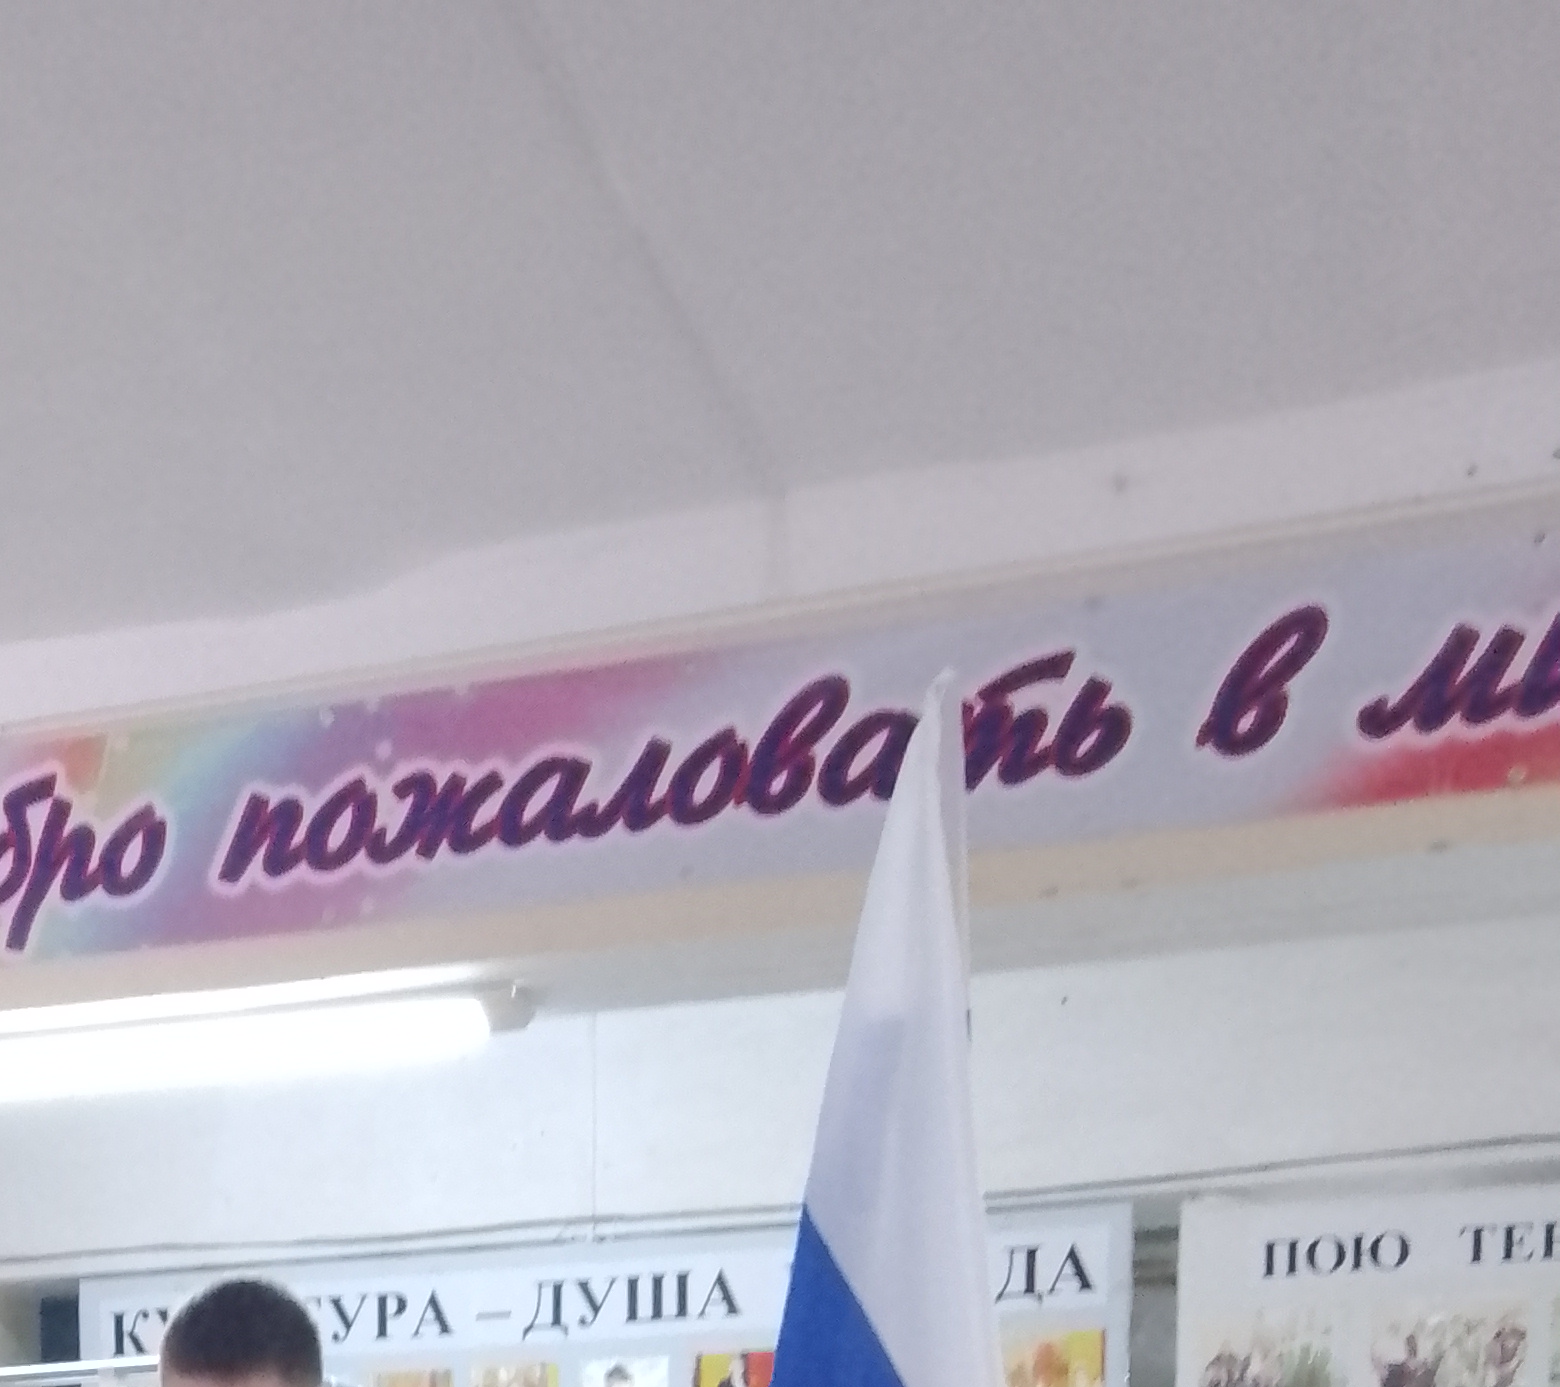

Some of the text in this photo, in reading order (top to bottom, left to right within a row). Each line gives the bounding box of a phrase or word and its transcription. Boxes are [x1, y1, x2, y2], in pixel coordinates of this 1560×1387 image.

[216, 648, 1133, 885] пожаловать
[1195, 603, 1329, 758] в
[1261, 1229, 1411, 1280] ПОЮ
